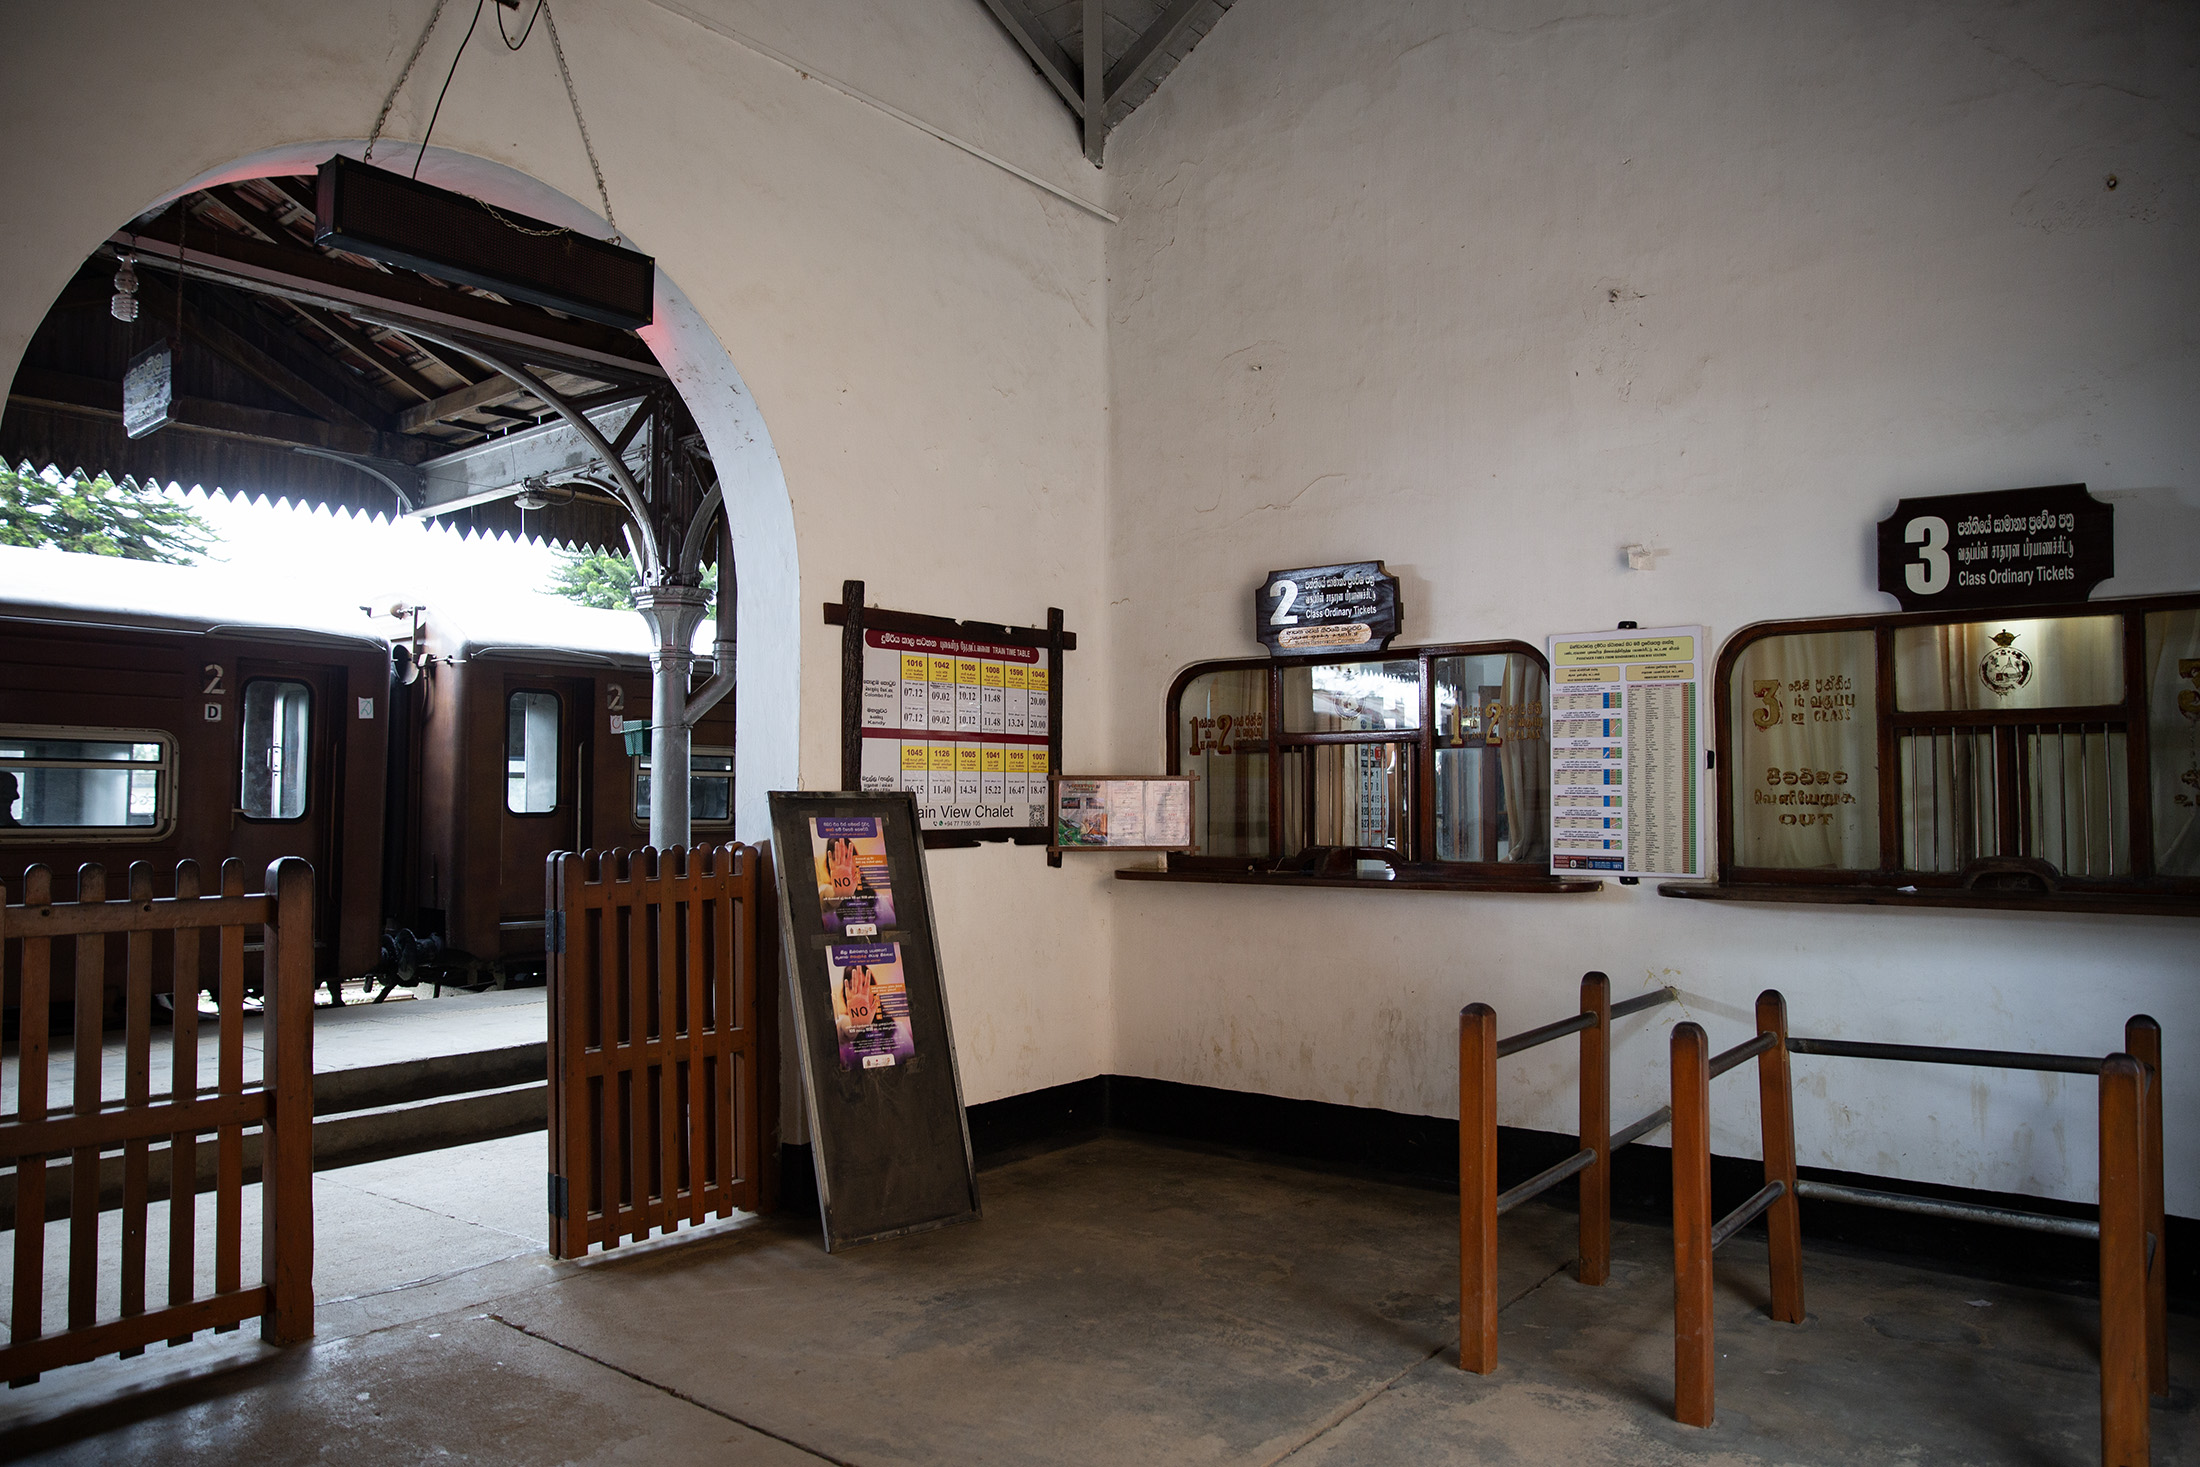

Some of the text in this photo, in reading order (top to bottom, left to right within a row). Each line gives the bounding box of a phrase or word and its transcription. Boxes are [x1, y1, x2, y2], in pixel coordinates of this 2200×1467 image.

[1904, 515, 1950, 595] 3
[1958, 565, 2075, 586] Class Ordinary Tickets
[1269, 579, 1299, 626] 2
[1305, 605, 1377, 619] Class Ordinary Tickets
[992, 646, 1030, 658] TRAIN TIME TABLE
[906, 659, 1046, 678] 1016 1042 1006 1008 1596 1046
[203, 664, 226, 694] 2
[607, 684, 624, 710] 2
[904, 688, 923, 697] 07.12
[931, 691, 950, 701] 09.02
[959, 691, 976, 701] 10.12
[984, 693, 1001, 703] 11.48
[1030, 697, 1047, 706] 20.00
[207, 706, 219, 718] D
[1752, 679, 1781, 731] 3
[904, 713, 1046, 728] 07.12 09.02 10.12 11.48 13.24 20.00
[1813, 708, 1851, 722] CLASS
[1450, 704, 1464, 747] 1
[1485, 703, 1503, 747] 2
[1189, 716, 1201, 755] 1
[1217, 714, 1232, 754] 2
[961, 750, 976, 758] 1005
[986, 751, 1000, 759] 1041
[905, 785, 1047, 795] 0615 11.40 14.34 15.22 16.47 18.47
[940, 805, 971, 818] View
[975, 804, 1014, 818] Chalet
[1779, 813, 1834, 827] OUT
[833, 877, 851, 888] NO
[850, 1006, 868, 1018] NO
